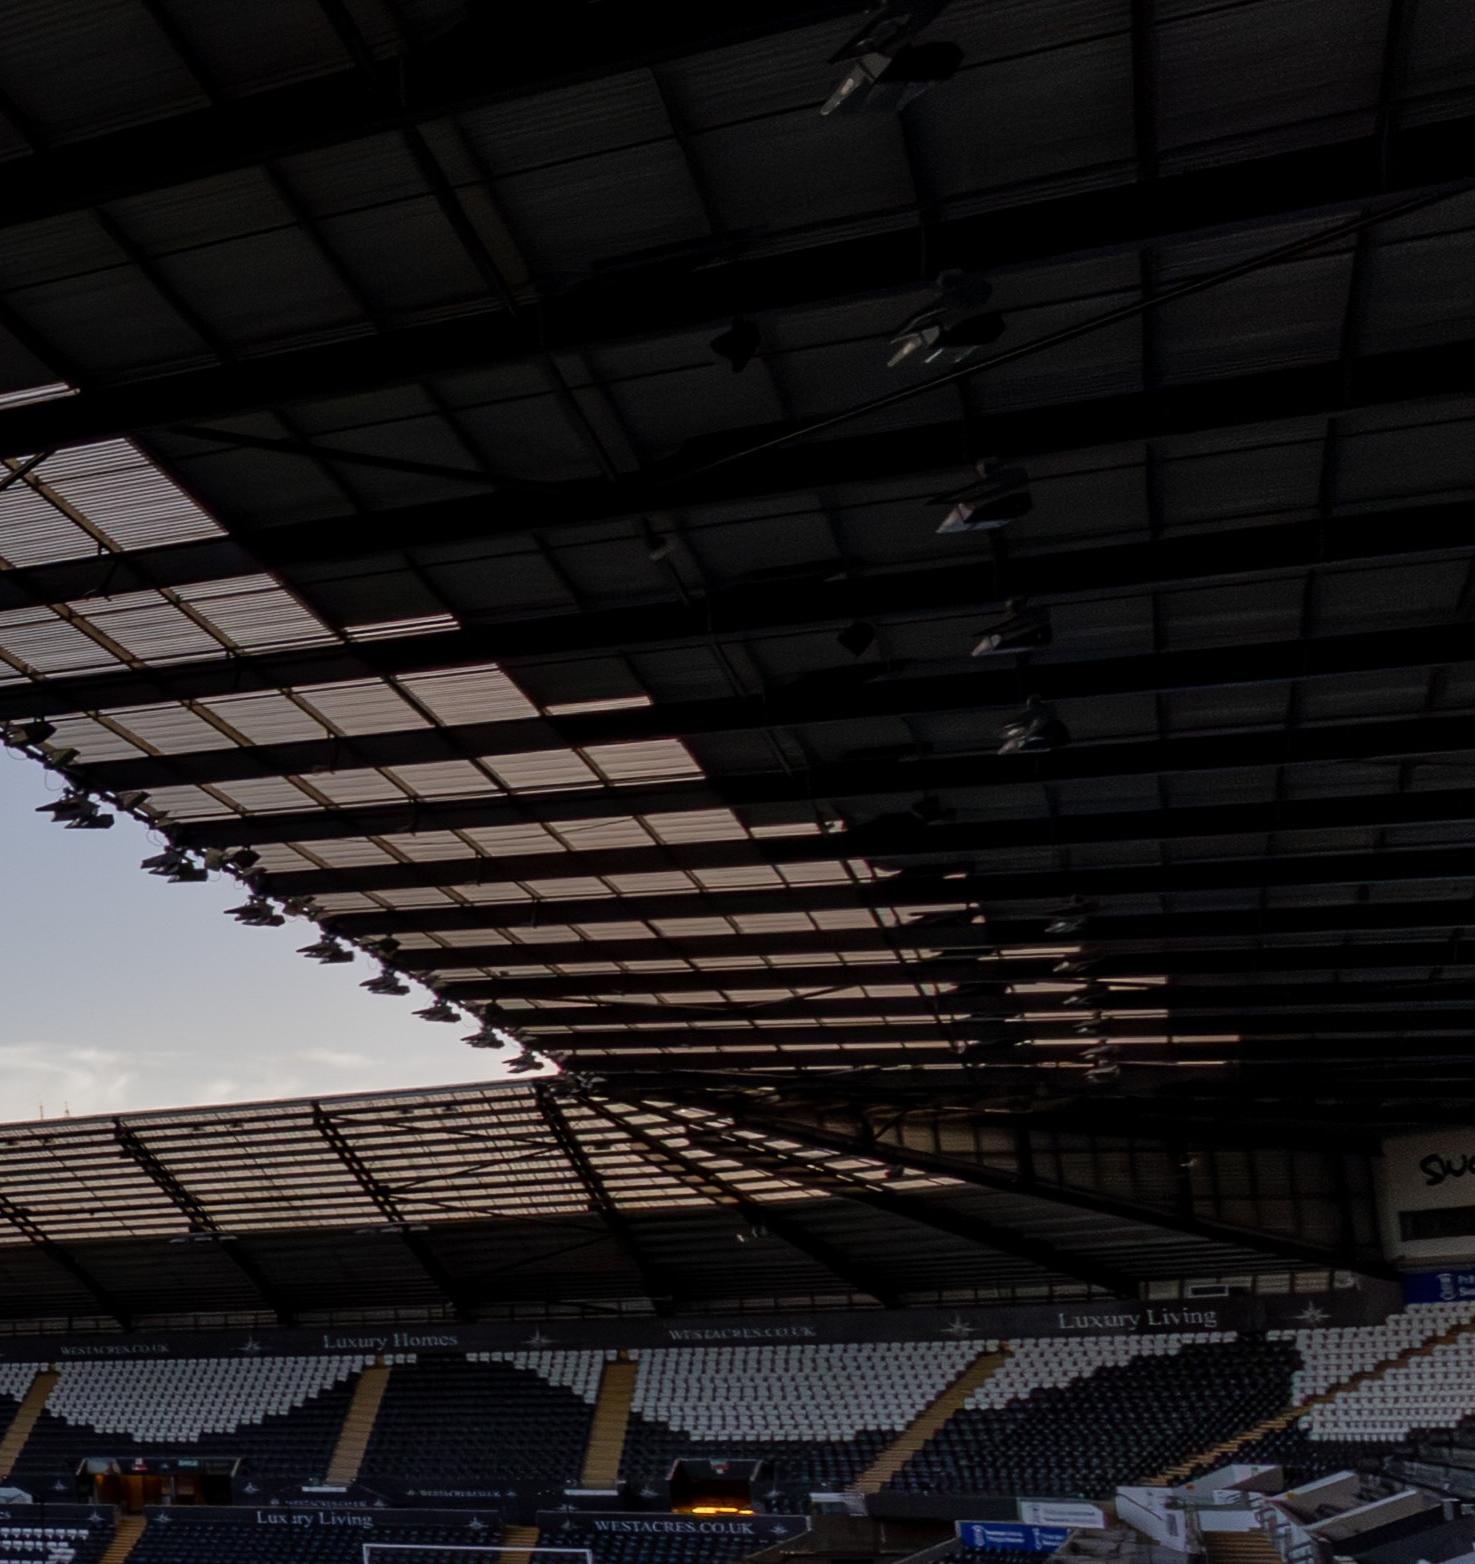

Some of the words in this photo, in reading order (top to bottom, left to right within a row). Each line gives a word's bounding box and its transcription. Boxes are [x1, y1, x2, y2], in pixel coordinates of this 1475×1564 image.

[1058, 1310, 1140, 1331] Luxury
[1147, 1306, 1217, 1330] Living
[323, 1333, 388, 1351] Luxury
[393, 1333, 459, 1347] Homes
[669, 1327, 817, 1340] WESTACRES.CO.UK
[60, 1344, 170, 1356] WESTACRES.CO.UK
[256, 1509, 314, 1527] Luxury
[319, 1510, 374, 1528] Living
[594, 1519, 755, 1536] WESTACRES.CO.UK
